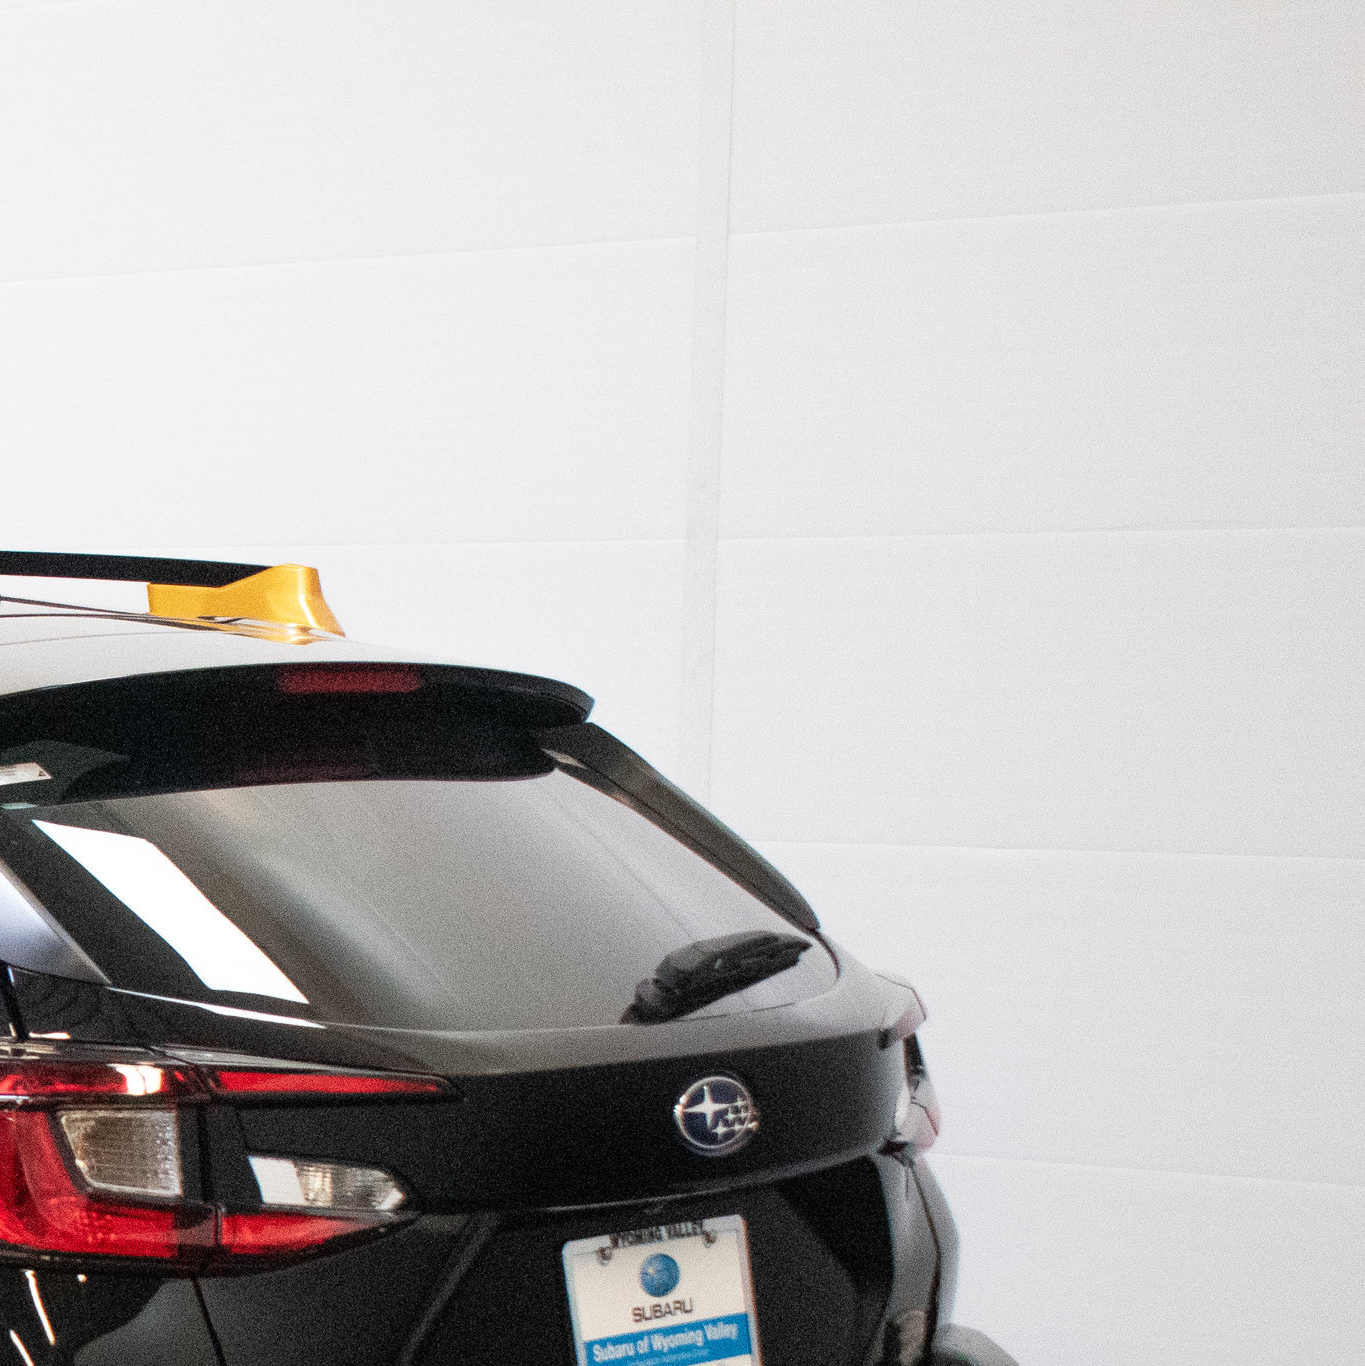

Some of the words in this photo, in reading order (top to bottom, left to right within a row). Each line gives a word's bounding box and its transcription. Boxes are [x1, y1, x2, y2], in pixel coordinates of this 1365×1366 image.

[631, 1297, 694, 1323] SUBARU
[592, 1340, 634, 1363] Subaru
[636, 1335, 649, 1353] of
[651, 1328, 705, 1353] Wyoming
[704, 1321, 739, 1342] Valley
